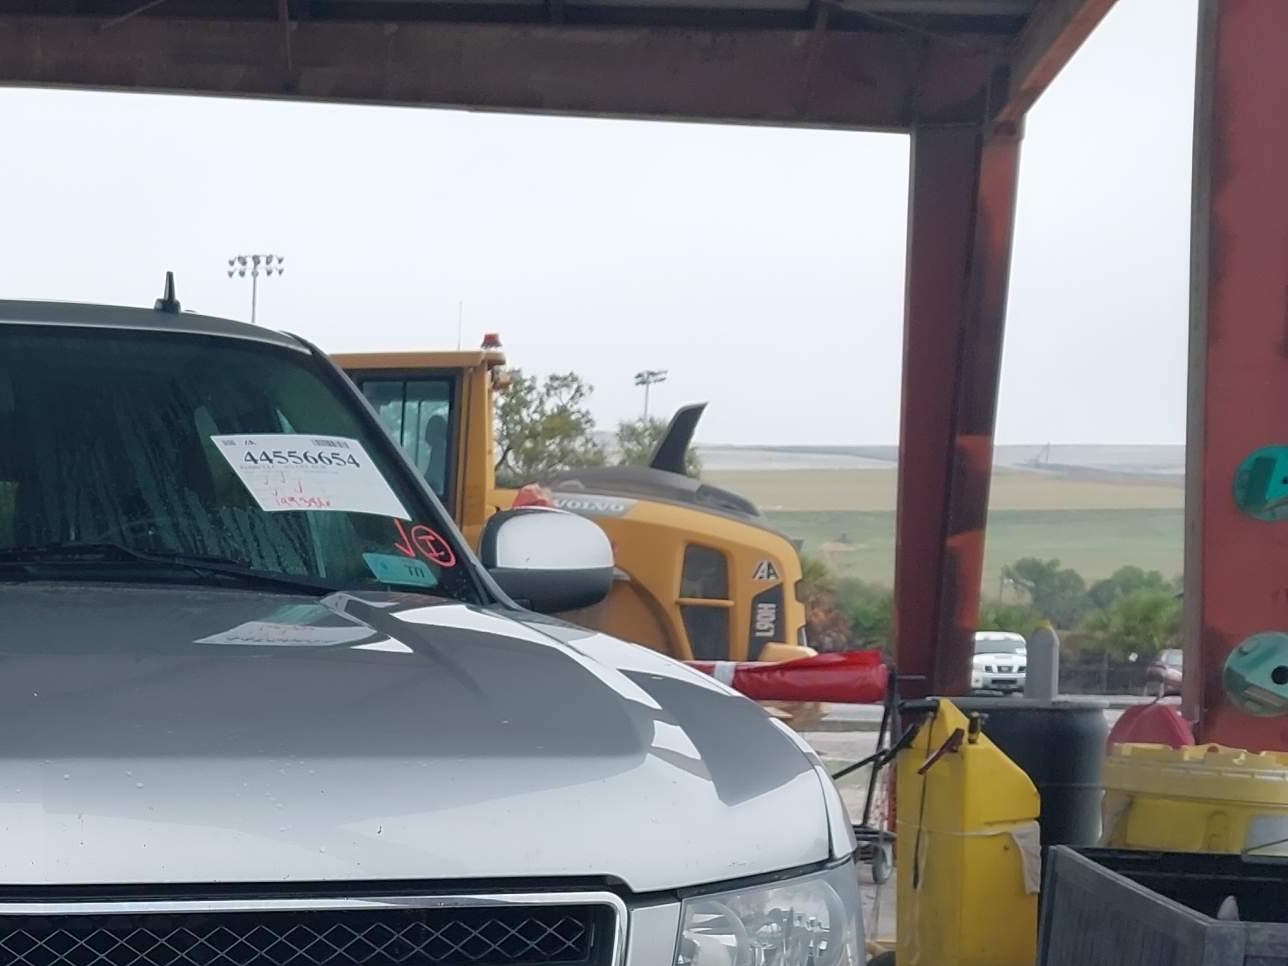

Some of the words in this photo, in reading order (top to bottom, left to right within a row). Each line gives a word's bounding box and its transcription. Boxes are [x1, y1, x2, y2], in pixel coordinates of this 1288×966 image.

[244, 450, 361, 468] 44556654
[553, 498, 625, 512] VOLVO
[755, 602, 777, 638] L90H
